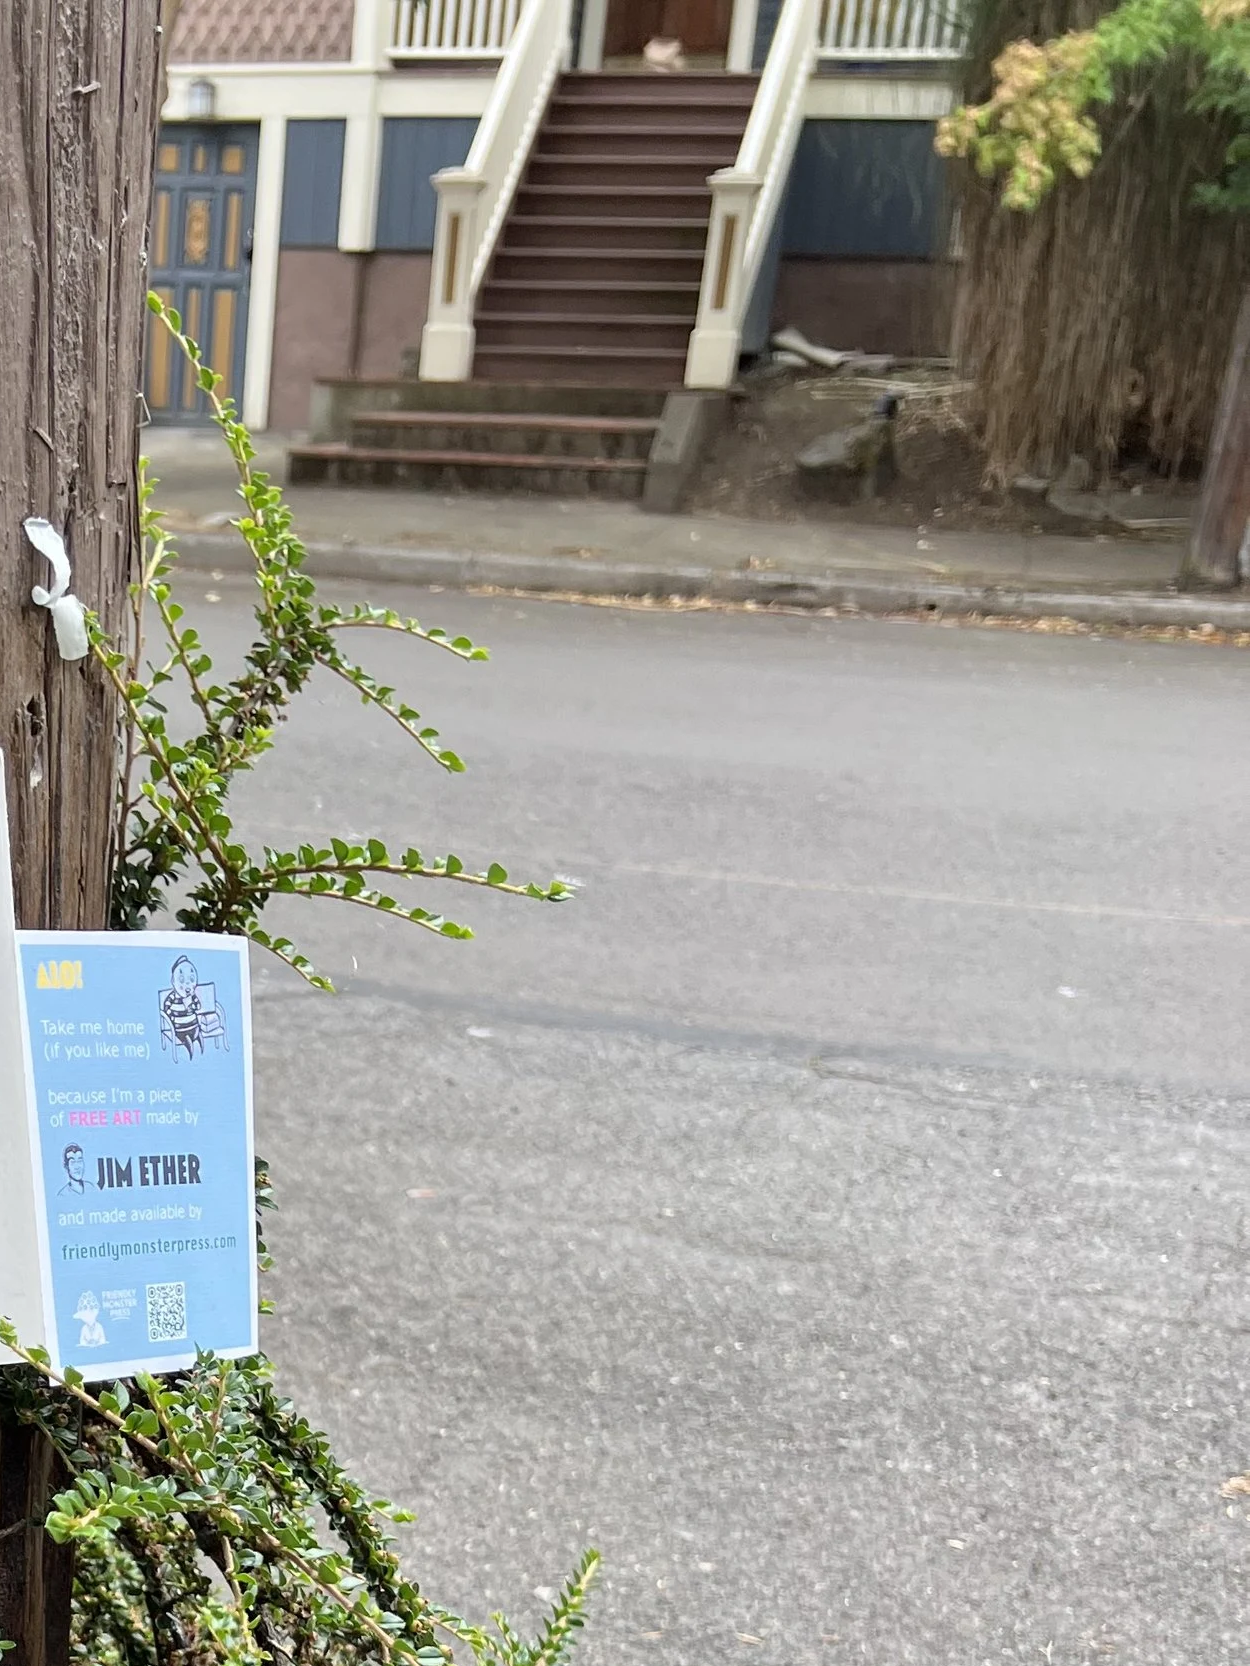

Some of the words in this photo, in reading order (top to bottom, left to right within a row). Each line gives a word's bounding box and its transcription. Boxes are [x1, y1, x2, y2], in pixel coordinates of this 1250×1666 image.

[40, 1019, 75, 1036] Take
[80, 1022, 103, 1036] me
[106, 1018, 146, 1036] home
[44, 1042, 60, 1062] (if
[65, 1044, 91, 1061] you
[95, 1041, 120, 1058] like
[124, 1041, 150, 1061] me)
[47, 1088, 106, 1105] because
[111, 1088, 133, 1103] I'm
[137, 1090, 146, 1102] a
[150, 1088, 183, 1105] piece
[50, 1111, 65, 1128] of
[68, 1111, 108, 1127] FREE
[112, 1110, 142, 1126] ART
[146, 1109, 181, 1125] made
[185, 1108, 200, 1127] by
[96, 1156, 134, 1190] JIM
[138, 1153, 202, 1187] ETHER
[58, 1209, 85, 1226] and
[89, 1207, 127, 1224] made
[130, 1203, 187, 1222] available
[188, 1203, 203, 1220] by
[61, 1235, 237, 1261] friendlymonsterpress.com
